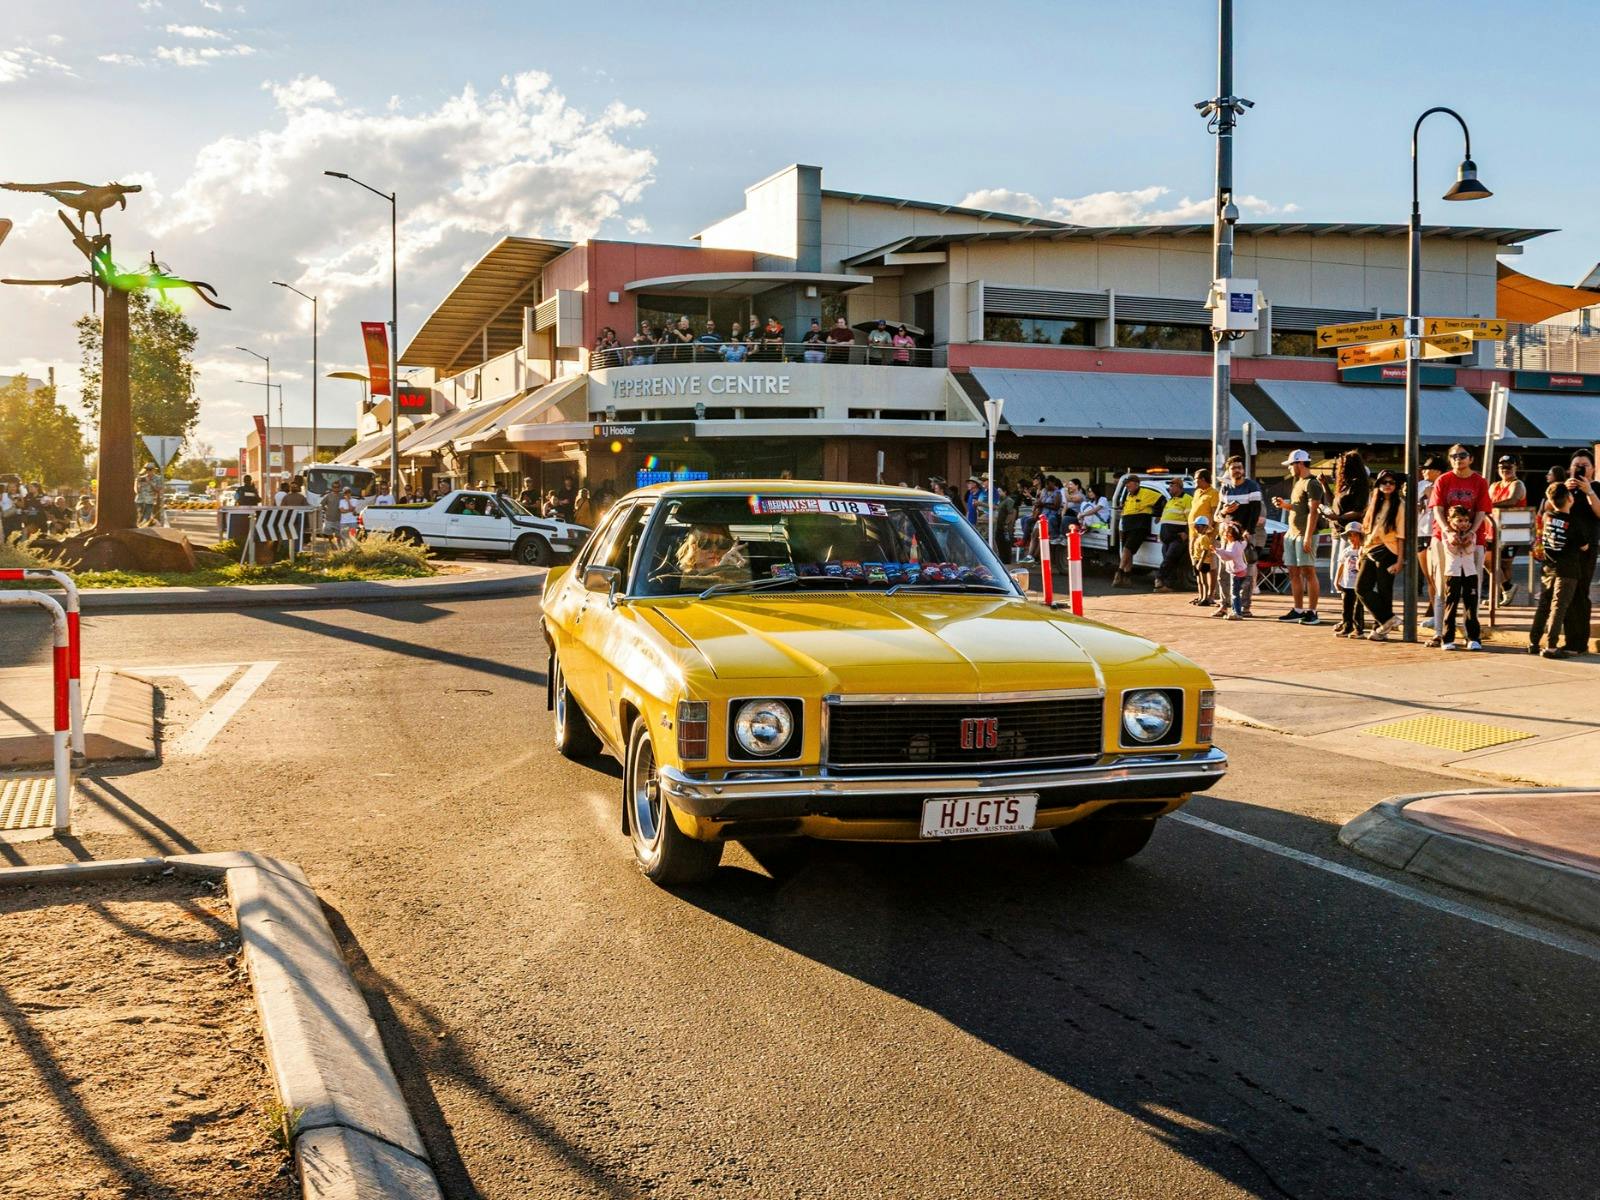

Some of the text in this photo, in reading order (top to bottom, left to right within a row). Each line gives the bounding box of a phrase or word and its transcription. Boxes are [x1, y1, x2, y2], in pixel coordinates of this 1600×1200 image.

[611, 374, 790, 398] YEPERENYE CENTRE
[609, 426, 636, 436] Hooker
[995, 451, 1020, 460] Hooker
[828, 500, 860, 514] 018
[960, 717, 998, 749] GTS
[944, 826, 980, 835] OUTBACK
[984, 824, 1025, 833] AUSTRALIA
